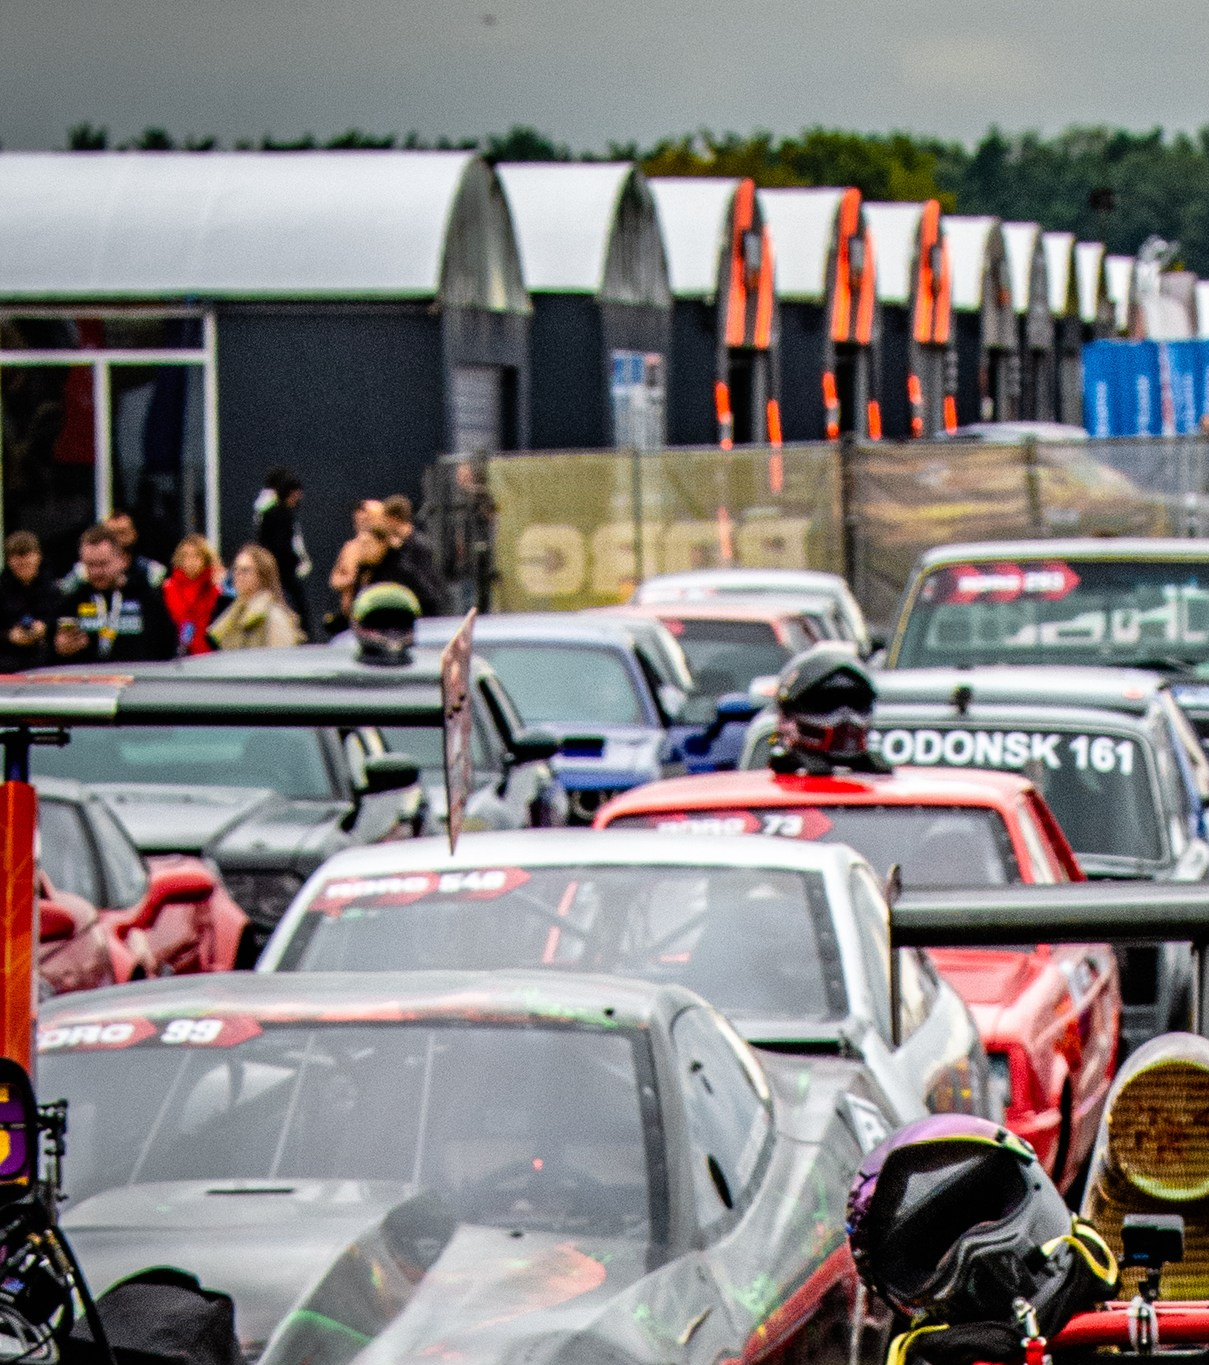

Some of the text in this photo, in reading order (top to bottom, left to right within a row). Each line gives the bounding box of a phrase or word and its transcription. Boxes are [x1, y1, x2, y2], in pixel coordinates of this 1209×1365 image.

[1069, 735, 1134, 776] 161
[36, 1018, 225, 1050] DRC 99
